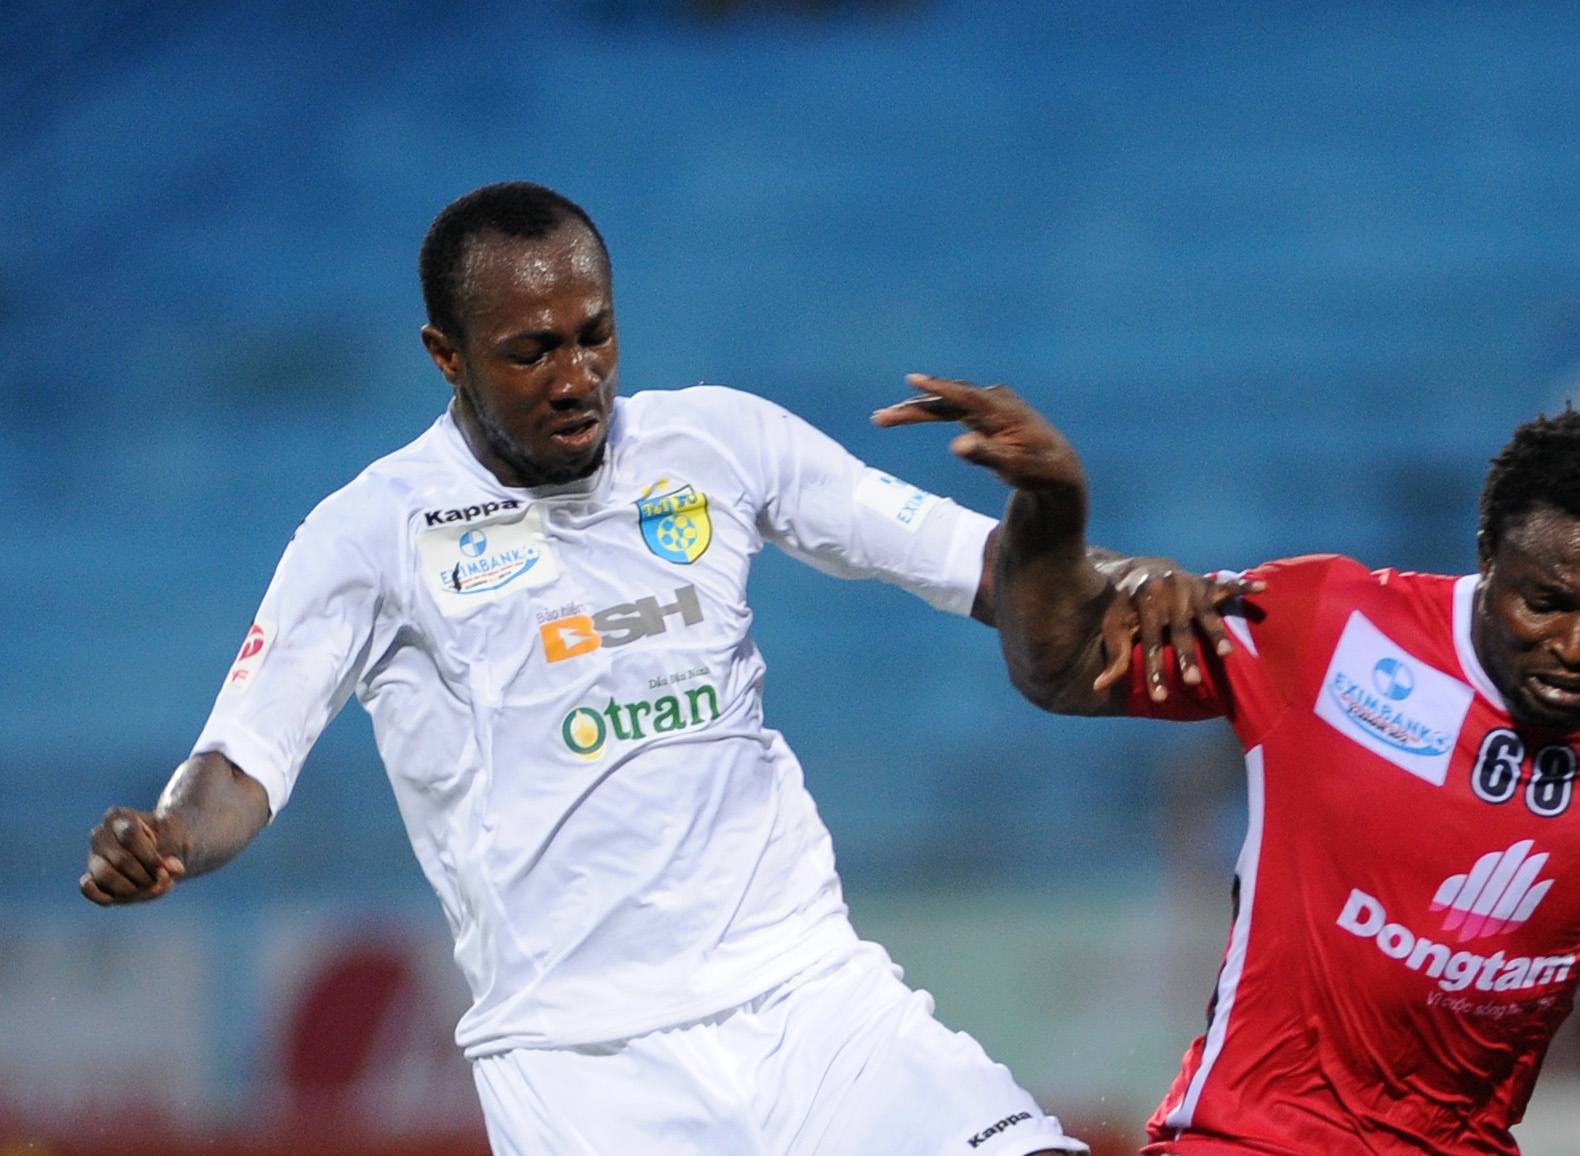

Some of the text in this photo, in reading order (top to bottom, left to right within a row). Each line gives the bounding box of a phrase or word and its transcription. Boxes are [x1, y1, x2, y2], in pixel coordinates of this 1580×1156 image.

[424, 500, 523, 526] Kappa
[440, 549, 524, 584] EIMBANK
[540, 584, 704, 664] BSH
[562, 684, 722, 757] Otran
[1471, 727, 1577, 819] 68
[1336, 888, 1577, 992] Dongtam
[967, 1111, 1033, 1149] Kappa
